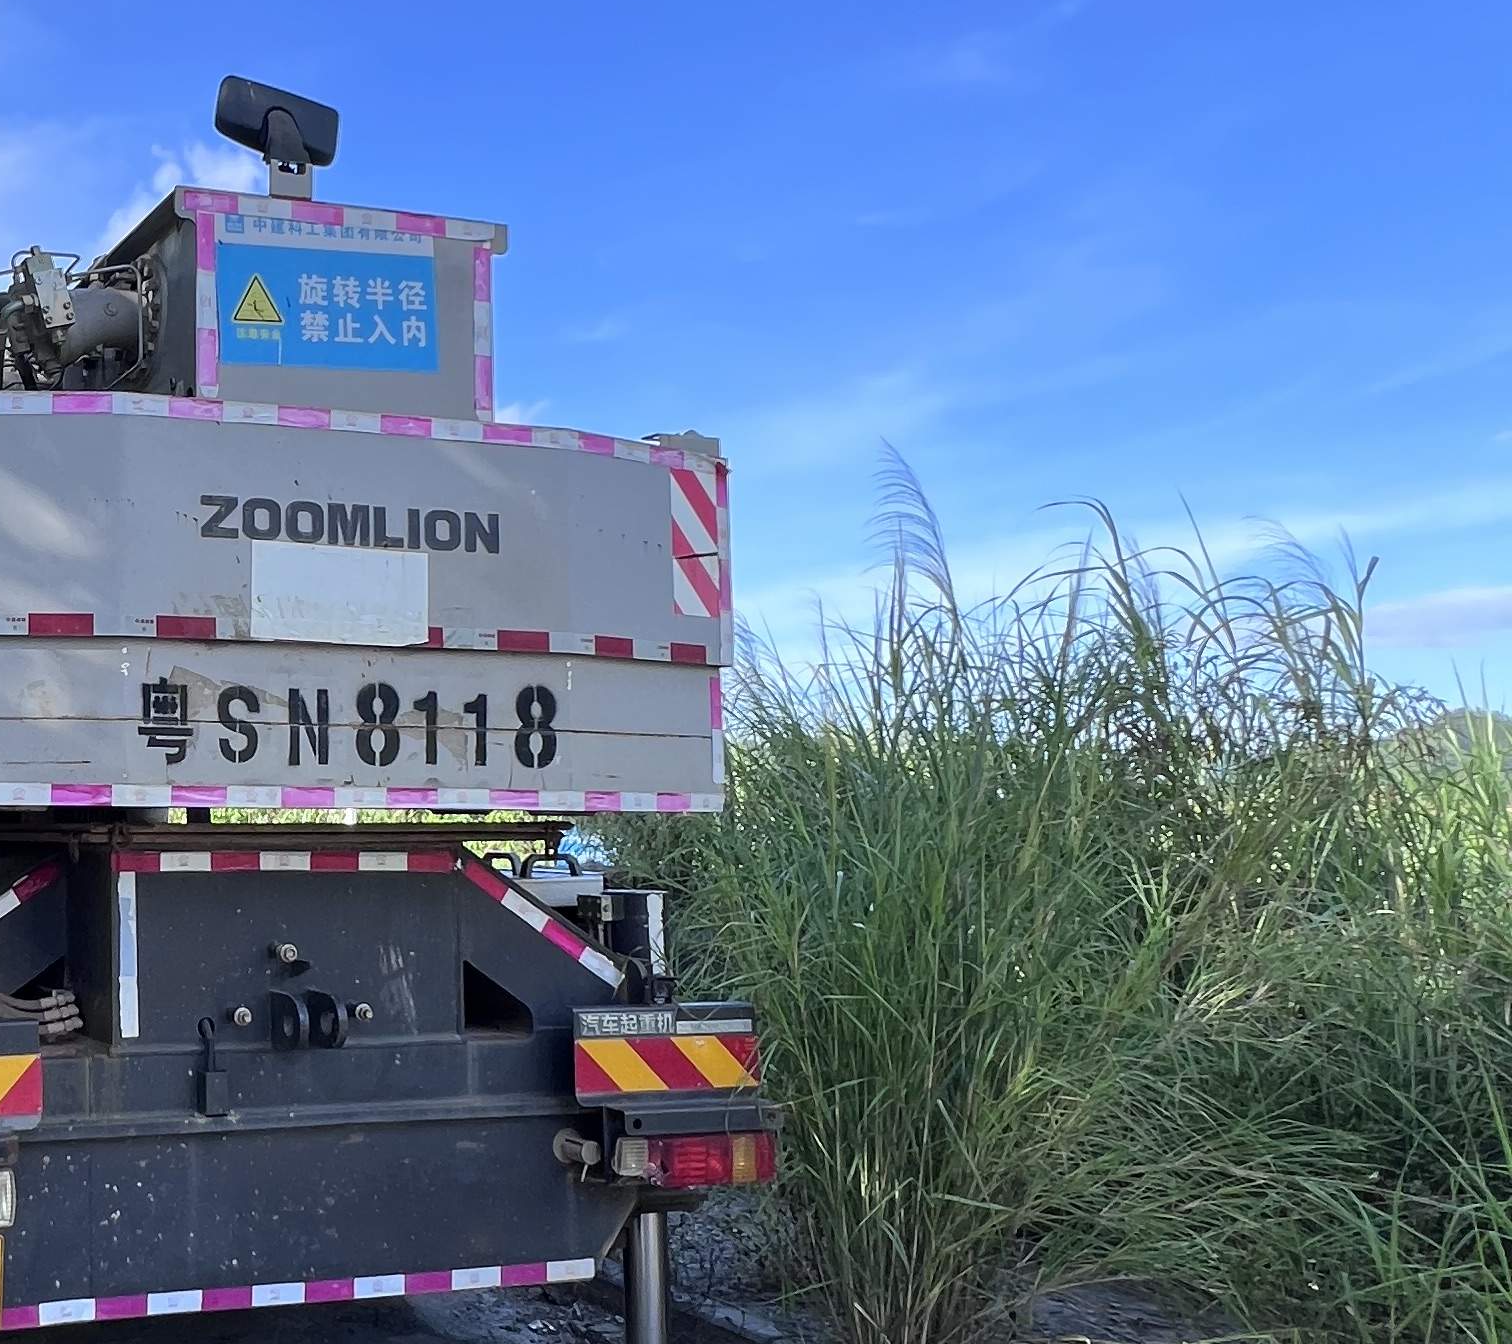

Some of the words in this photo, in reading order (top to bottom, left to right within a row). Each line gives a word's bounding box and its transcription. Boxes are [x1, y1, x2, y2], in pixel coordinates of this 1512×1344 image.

[297, 273, 428, 311] 旋转半径
[300, 309, 427, 347] 禁止入内
[200, 494, 500, 554] ZOOMLION
[581, 1012, 673, 1036] 汽车起重机
